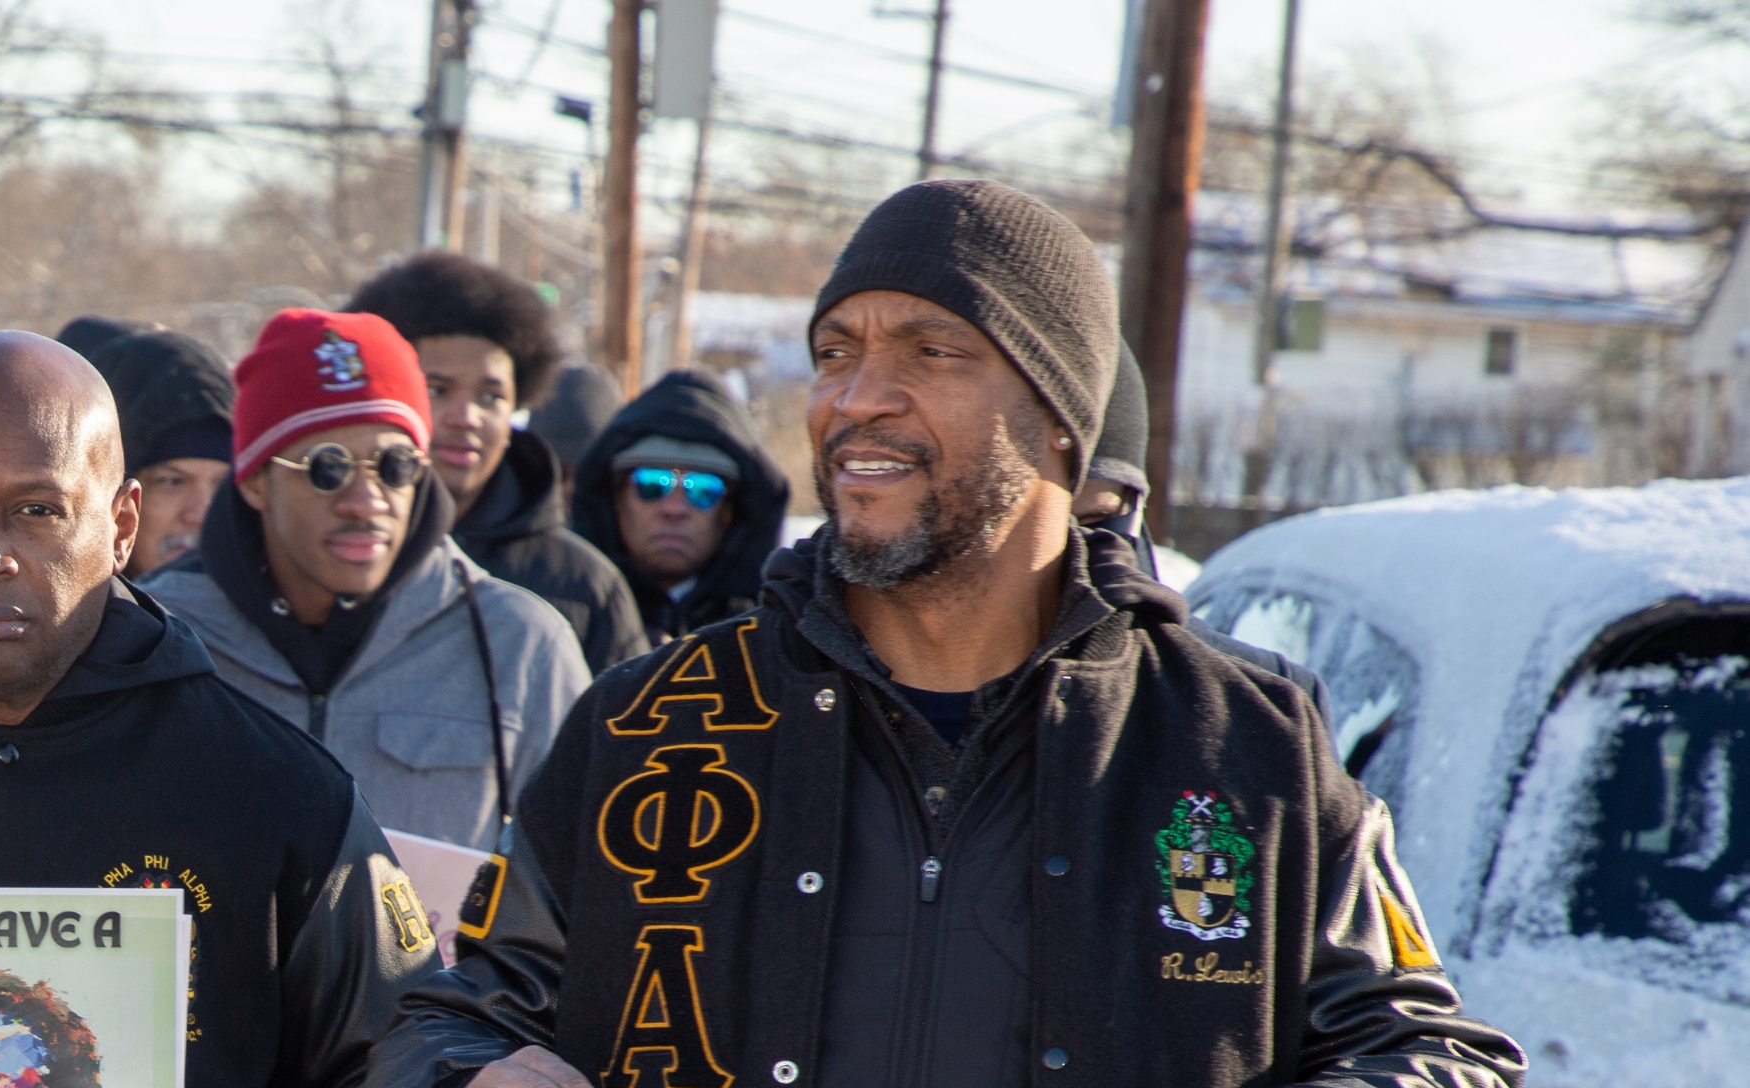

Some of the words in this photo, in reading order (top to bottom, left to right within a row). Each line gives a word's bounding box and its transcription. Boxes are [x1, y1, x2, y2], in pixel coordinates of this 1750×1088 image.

[144, 854, 170, 870] PHI
[178, 868, 213, 914] ALPHA
[93, 911, 122, 948] A
